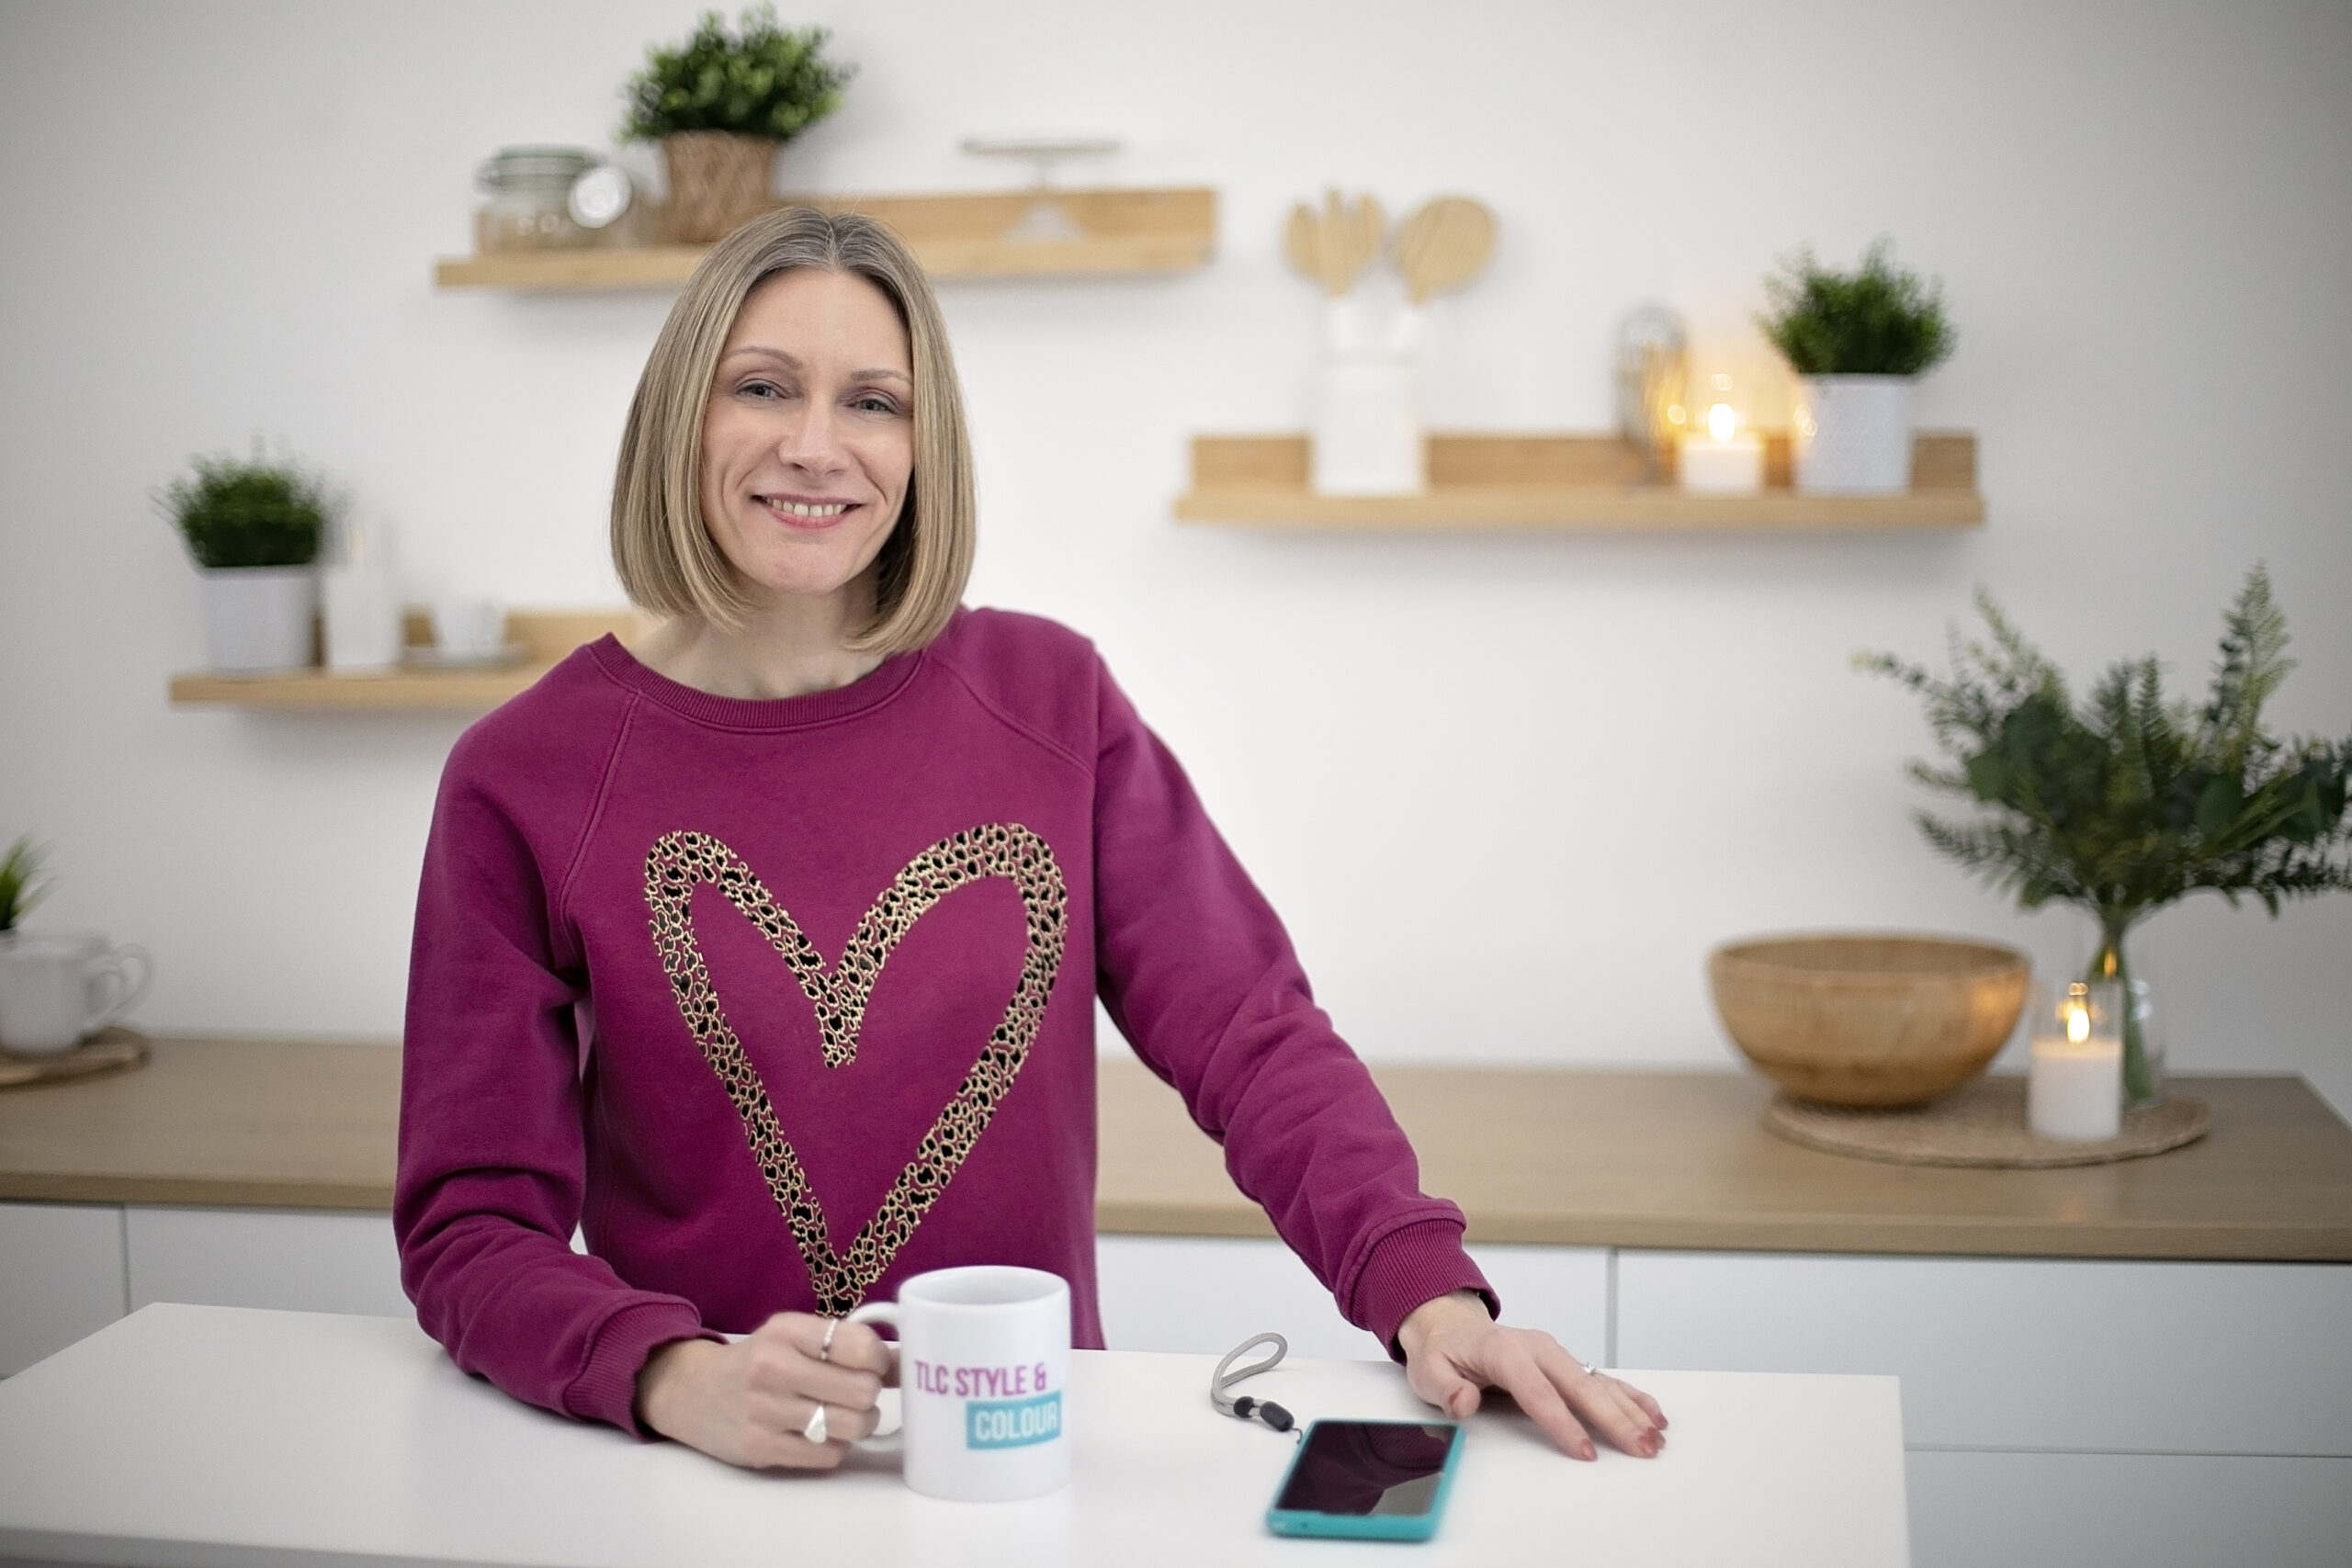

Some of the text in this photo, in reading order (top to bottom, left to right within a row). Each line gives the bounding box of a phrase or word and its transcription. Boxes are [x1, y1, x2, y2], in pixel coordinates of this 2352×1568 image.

[915, 1359, 1047, 1397] TLC STYLE &
[974, 1401, 1058, 1441] COLOUR
